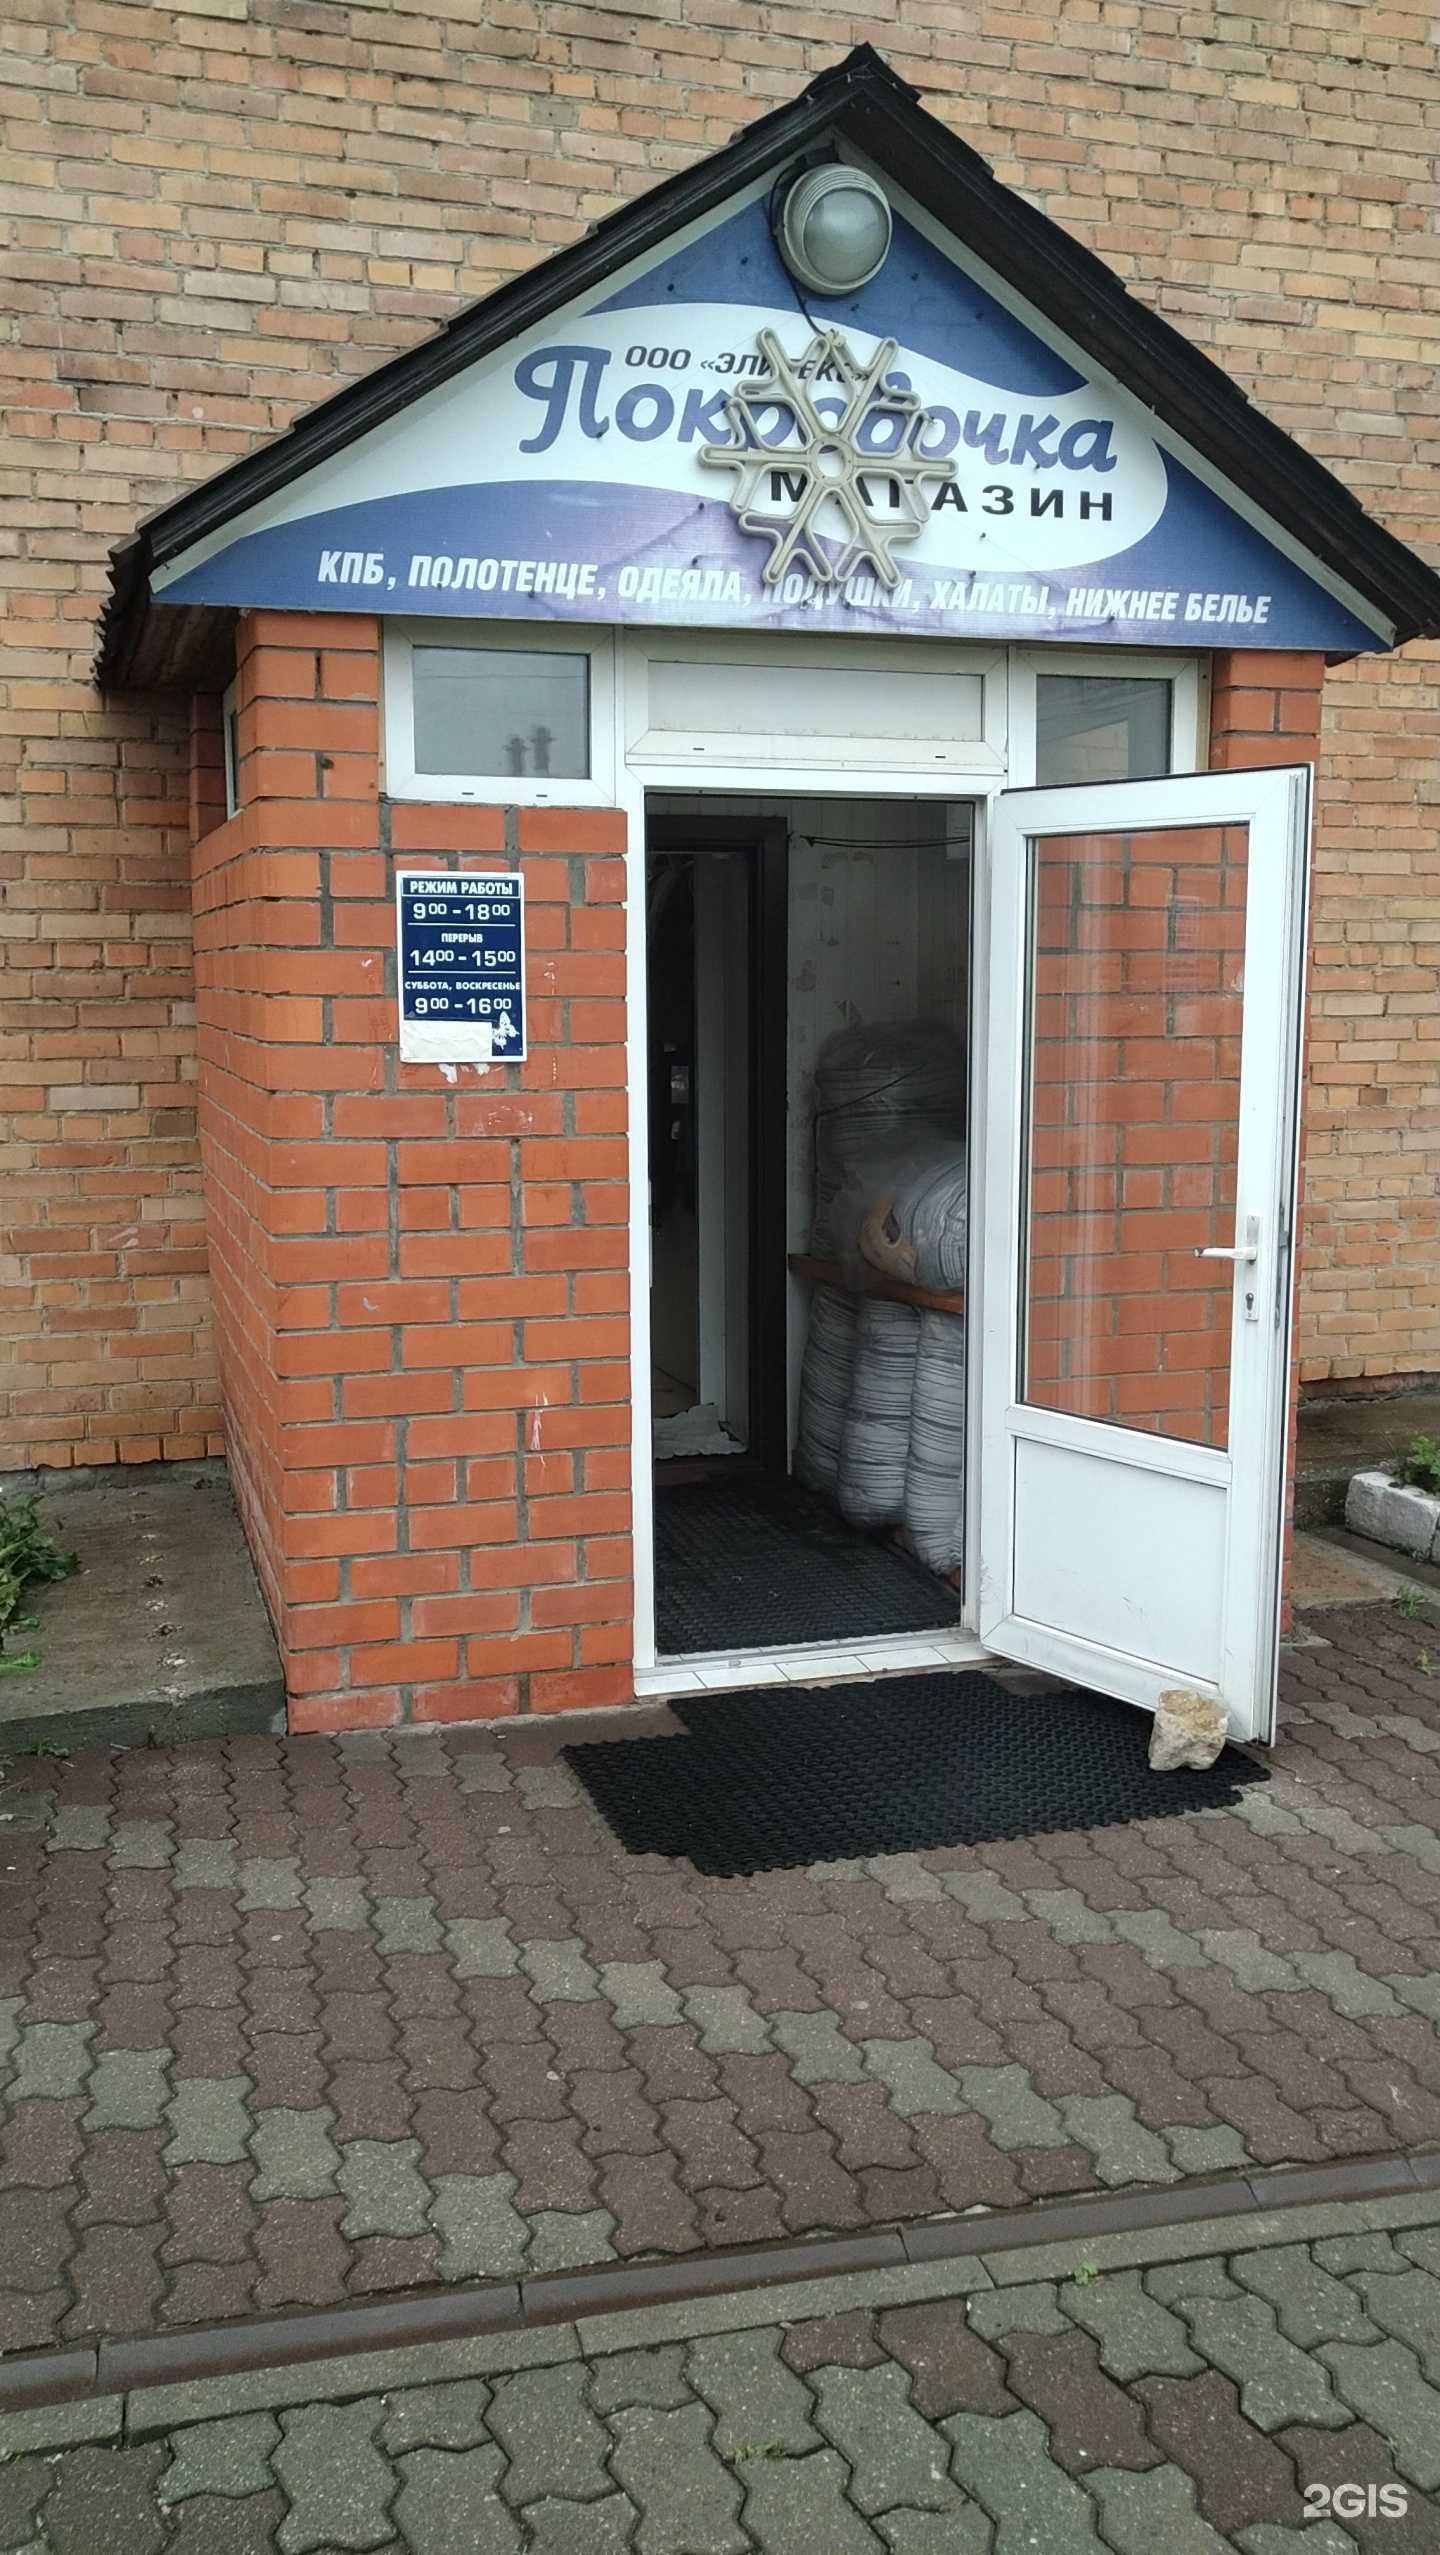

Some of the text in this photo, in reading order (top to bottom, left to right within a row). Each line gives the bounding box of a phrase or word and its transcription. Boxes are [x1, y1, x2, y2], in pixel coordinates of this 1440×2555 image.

[625, 345, 870, 384] ООО «ЭЛИЕКС»
[318, 550, 396, 591] КПБ,
[408, 555, 606, 600] ПОЛОТЕНЦЕ,
[617, 566, 752, 606] ОДЕЯЛА,
[930, 581, 1056, 619] ХАЛАТЫ,
[1066, 587, 1180, 621] НИЖНЕЕ
[1185, 592, 1272, 625] БЕЛЬЕ
[410, 880, 513, 895] РЕЖИМ РАБОТЫ
[441, 933, 483, 943] ПЕРЕРЫВ
[405, 981, 520, 991] СУББОТА, ВОСКРЕСЕНЬЕ
